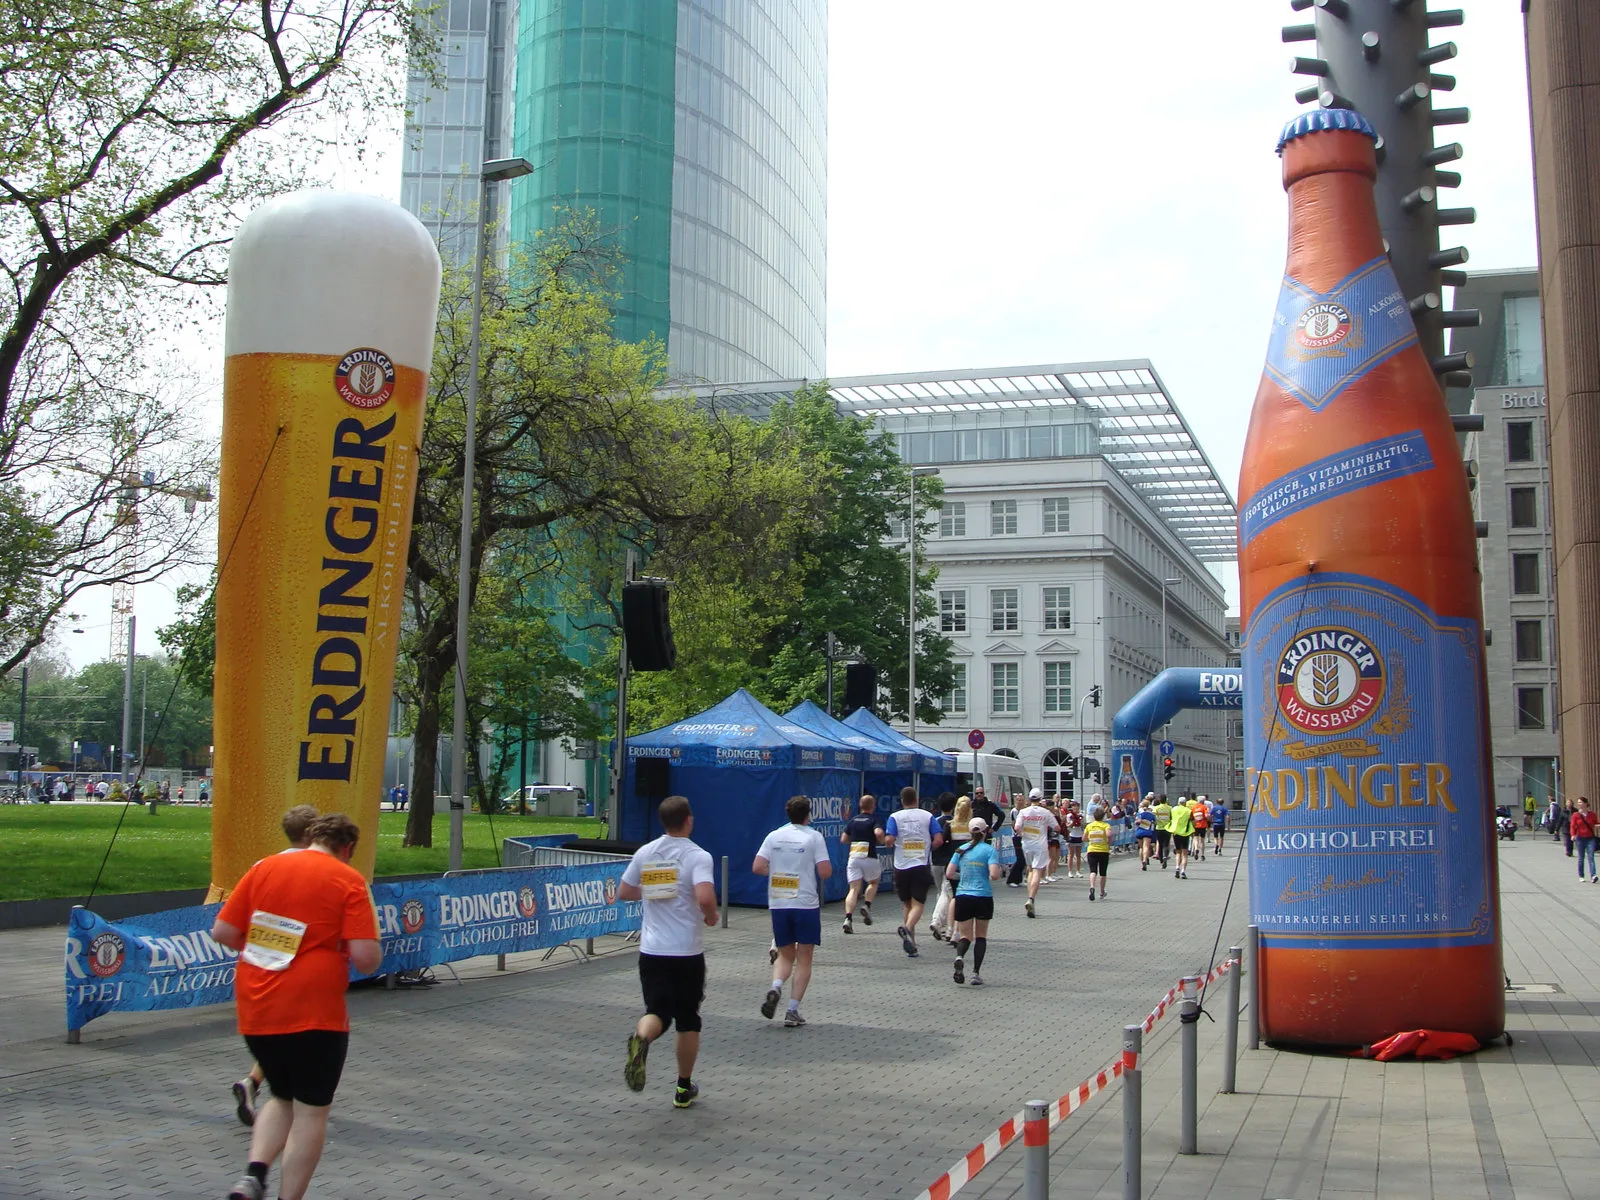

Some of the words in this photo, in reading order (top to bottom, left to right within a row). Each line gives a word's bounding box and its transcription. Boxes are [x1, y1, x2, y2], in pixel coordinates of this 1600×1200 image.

[339, 350, 394, 379] ERDINGER
[1500, 391, 1540, 409] Bird
[1262, 460, 1391, 519] KALORIENREDUZIERT
[297, 412, 396, 784] ERDINGER
[1279, 631, 1376, 677] ERDINGER
[1286, 691, 1374, 728] WEISSBRÄU
[672, 723, 741, 732] ERDINGER
[628, 746, 672, 757] ERDINGER
[715, 748, 761, 759] ERDINGER
[1256, 829, 1435, 851] ALKOHOLFREI
[439, 890, 521, 927] ERDINGER
[544, 880, 606, 912] ERDINGER
[1254, 914, 1360, 924] PRIVATBRAUEREI
[1370, 914, 1408, 924] SEIT
[1416, 913, 1448, 923] 1886
[437, 919, 539, 949] ALKOHOLFREI
